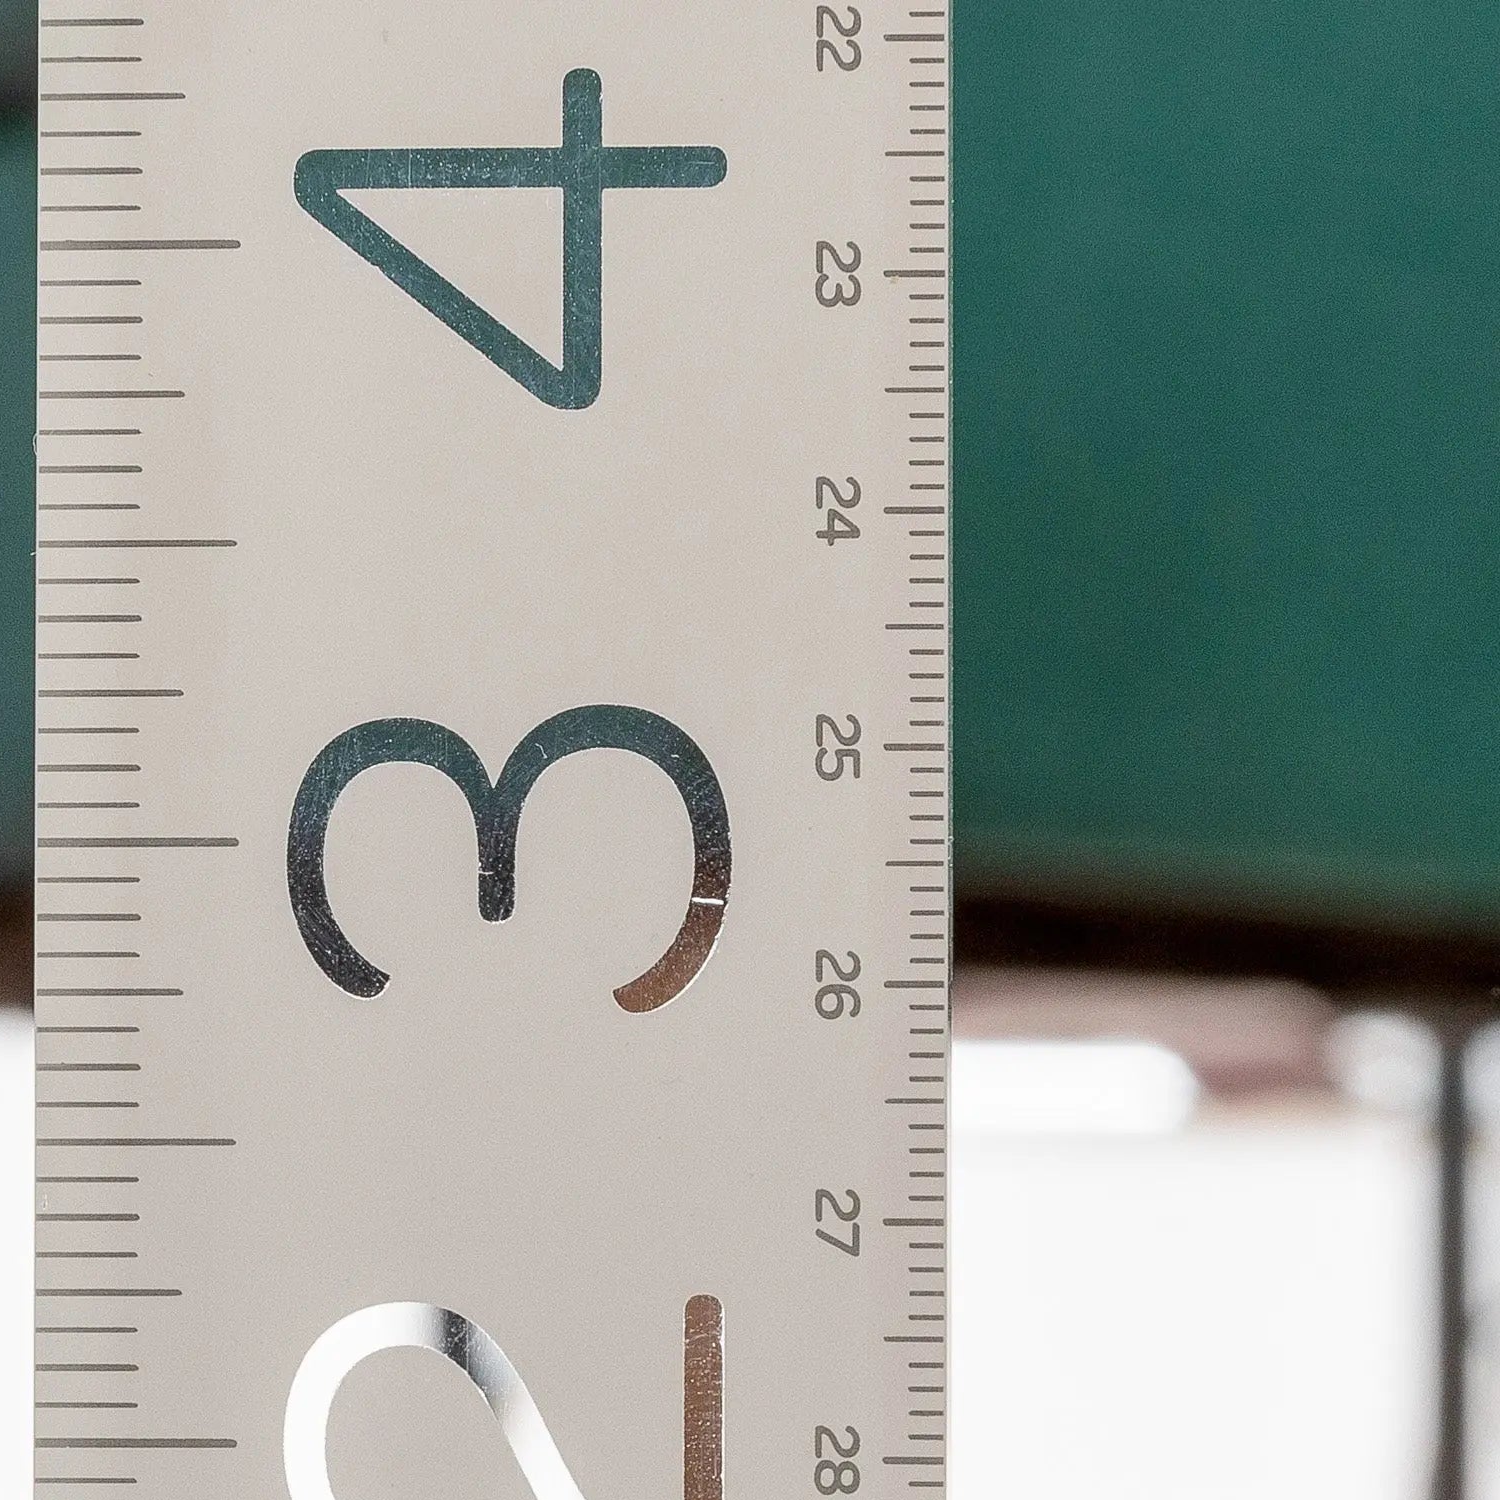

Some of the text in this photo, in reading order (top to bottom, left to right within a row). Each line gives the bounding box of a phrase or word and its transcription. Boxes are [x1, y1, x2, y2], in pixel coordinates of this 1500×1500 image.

[815, 4, 862, 72] 22
[294, 67, 728, 410] 4
[814, 240, 862, 308] 23
[815, 475, 862, 546] 24
[814, 713, 862, 782] 25
[286, 704, 732, 1013] 3
[814, 948, 862, 1020] 26
[814, 1188, 861, 1258] 27
[813, 1424, 861, 1496] 28
